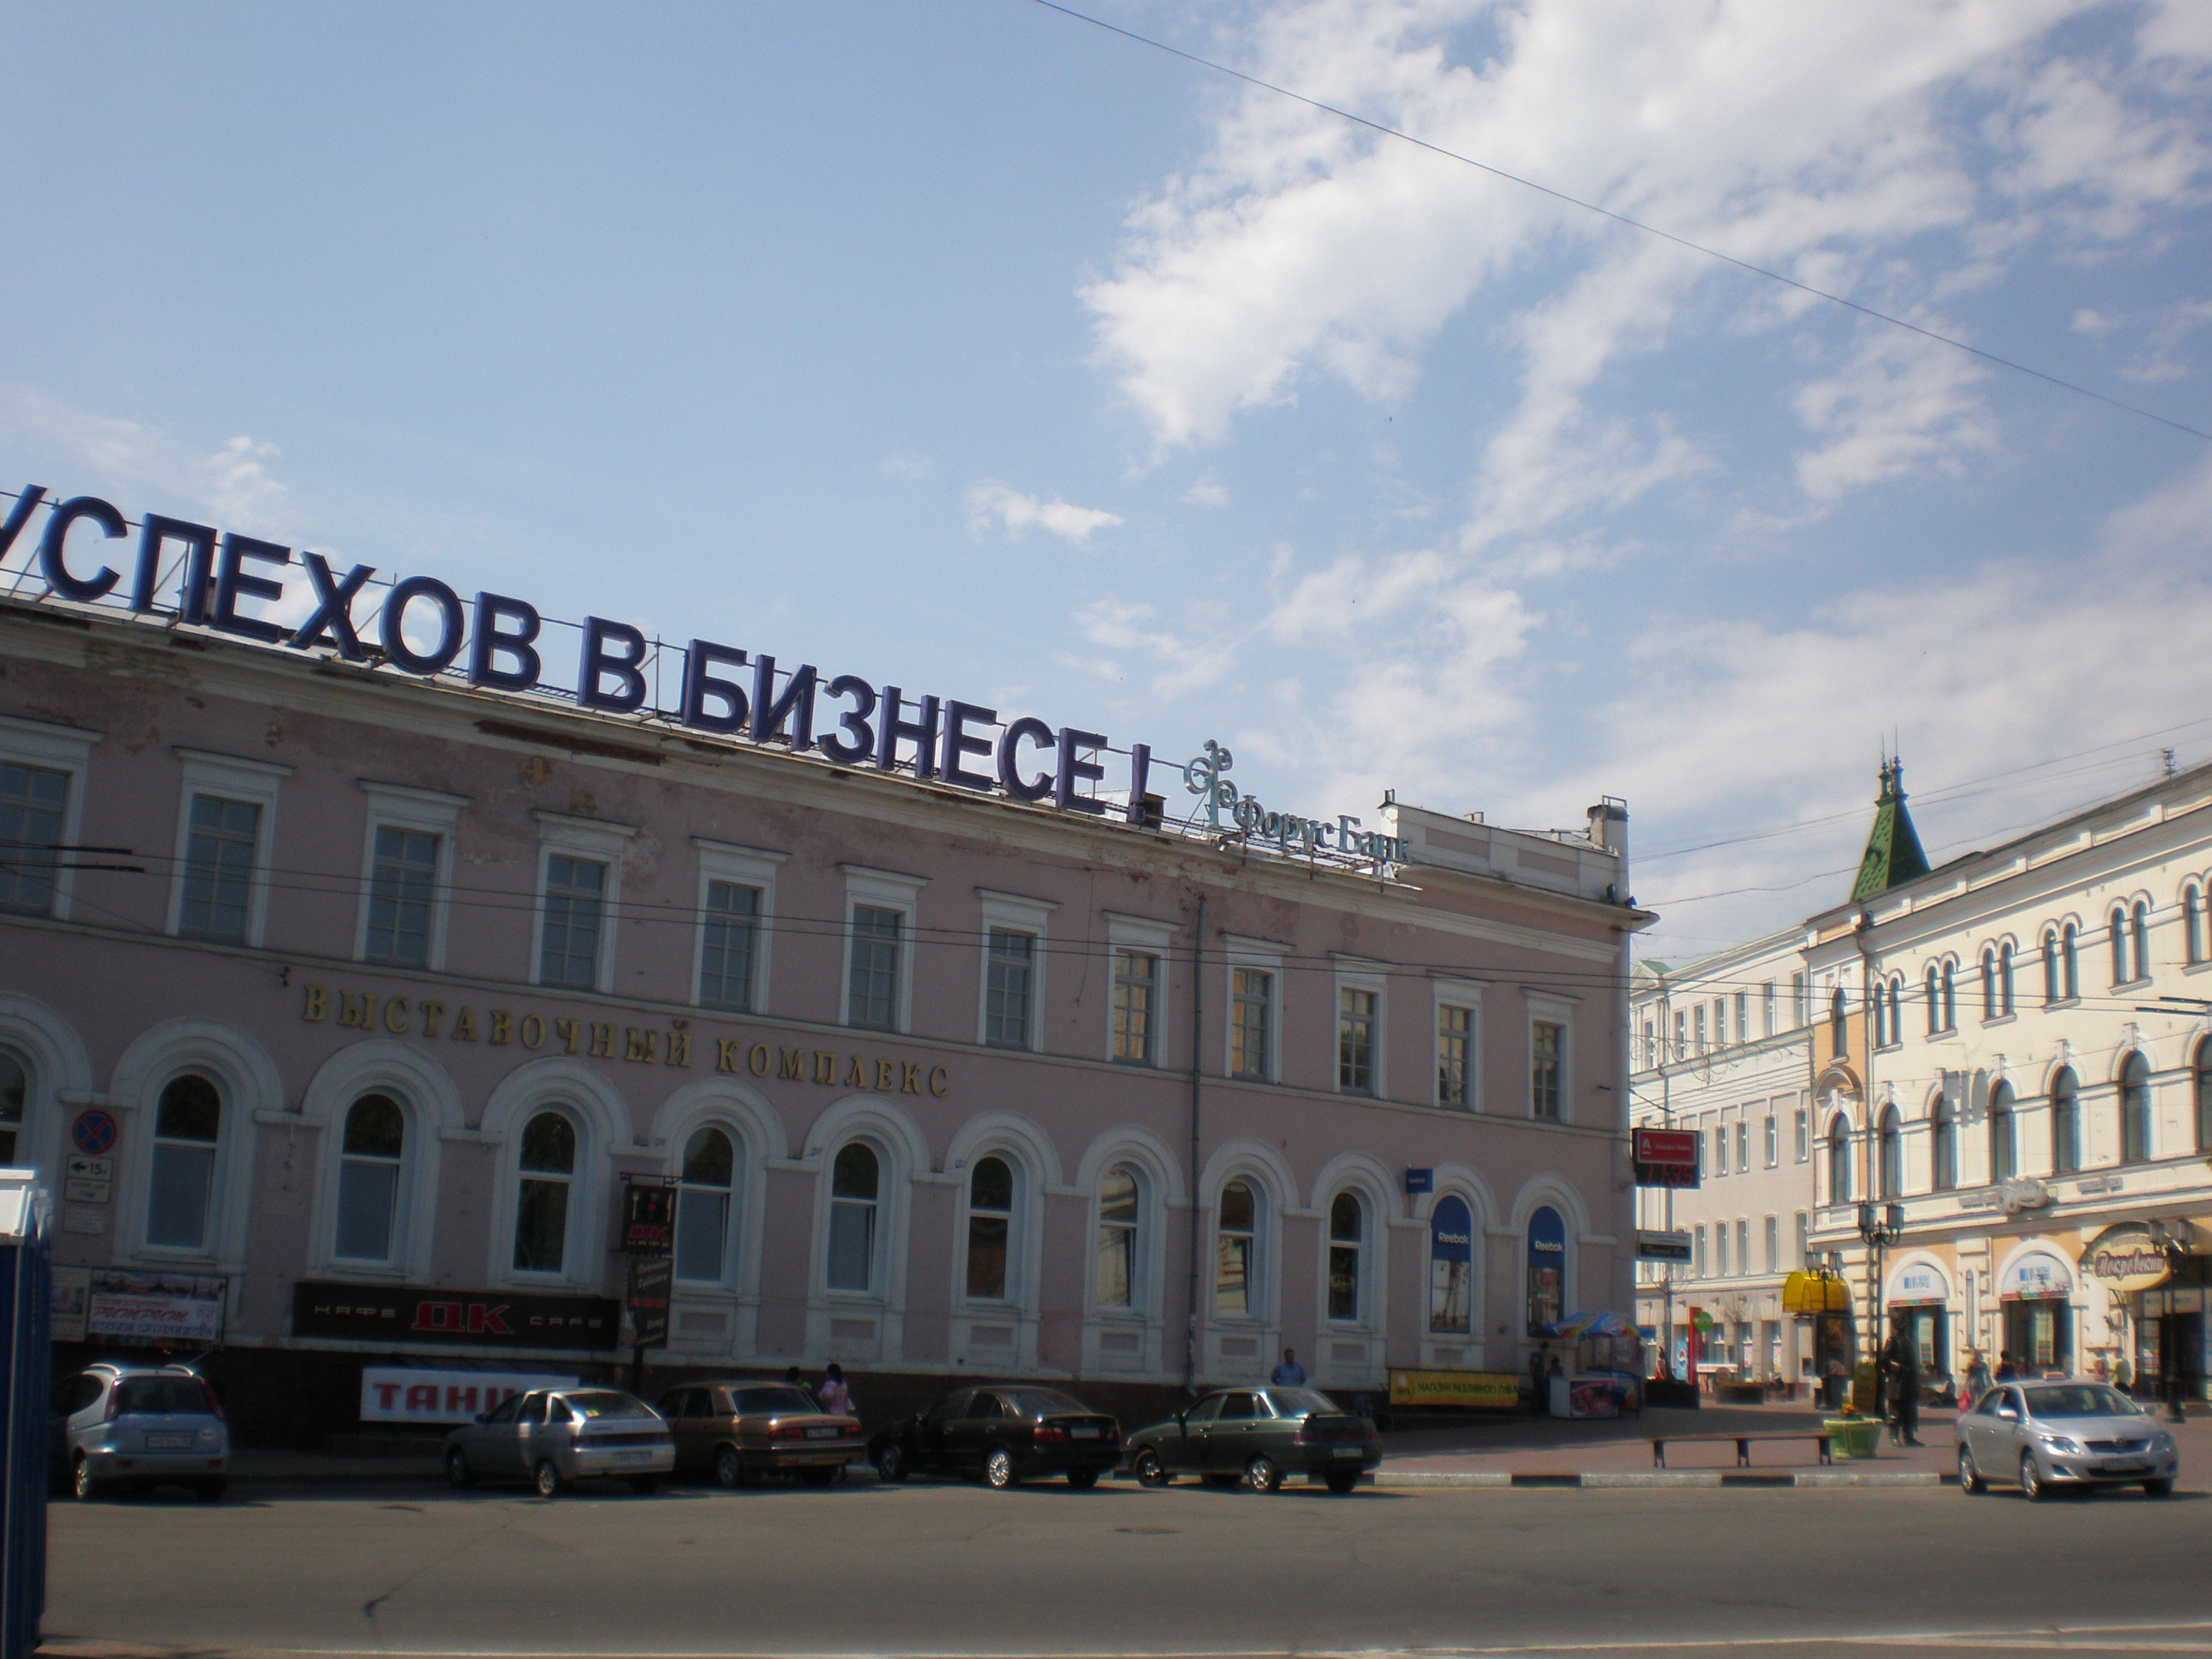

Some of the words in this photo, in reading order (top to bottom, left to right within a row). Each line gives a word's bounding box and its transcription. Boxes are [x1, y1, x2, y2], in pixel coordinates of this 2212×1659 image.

[577, 616, 647, 714] В
[302, 984, 694, 1067] ВЫСТАВОЧНЫЙ
[716, 1038, 948, 1097] КОМПЛЕКС
[629, 1225, 669, 1241] ДК
[1439, 1232, 1469, 1245] Reebok
[1534, 1240, 1563, 1253] Reebok
[314, 1304, 397, 1319] КАФЕ
[410, 1300, 515, 1335] ДК
[529, 1315, 603, 1329] CAFE
[1417, 1382, 1452, 1393] МАГАЗИН
